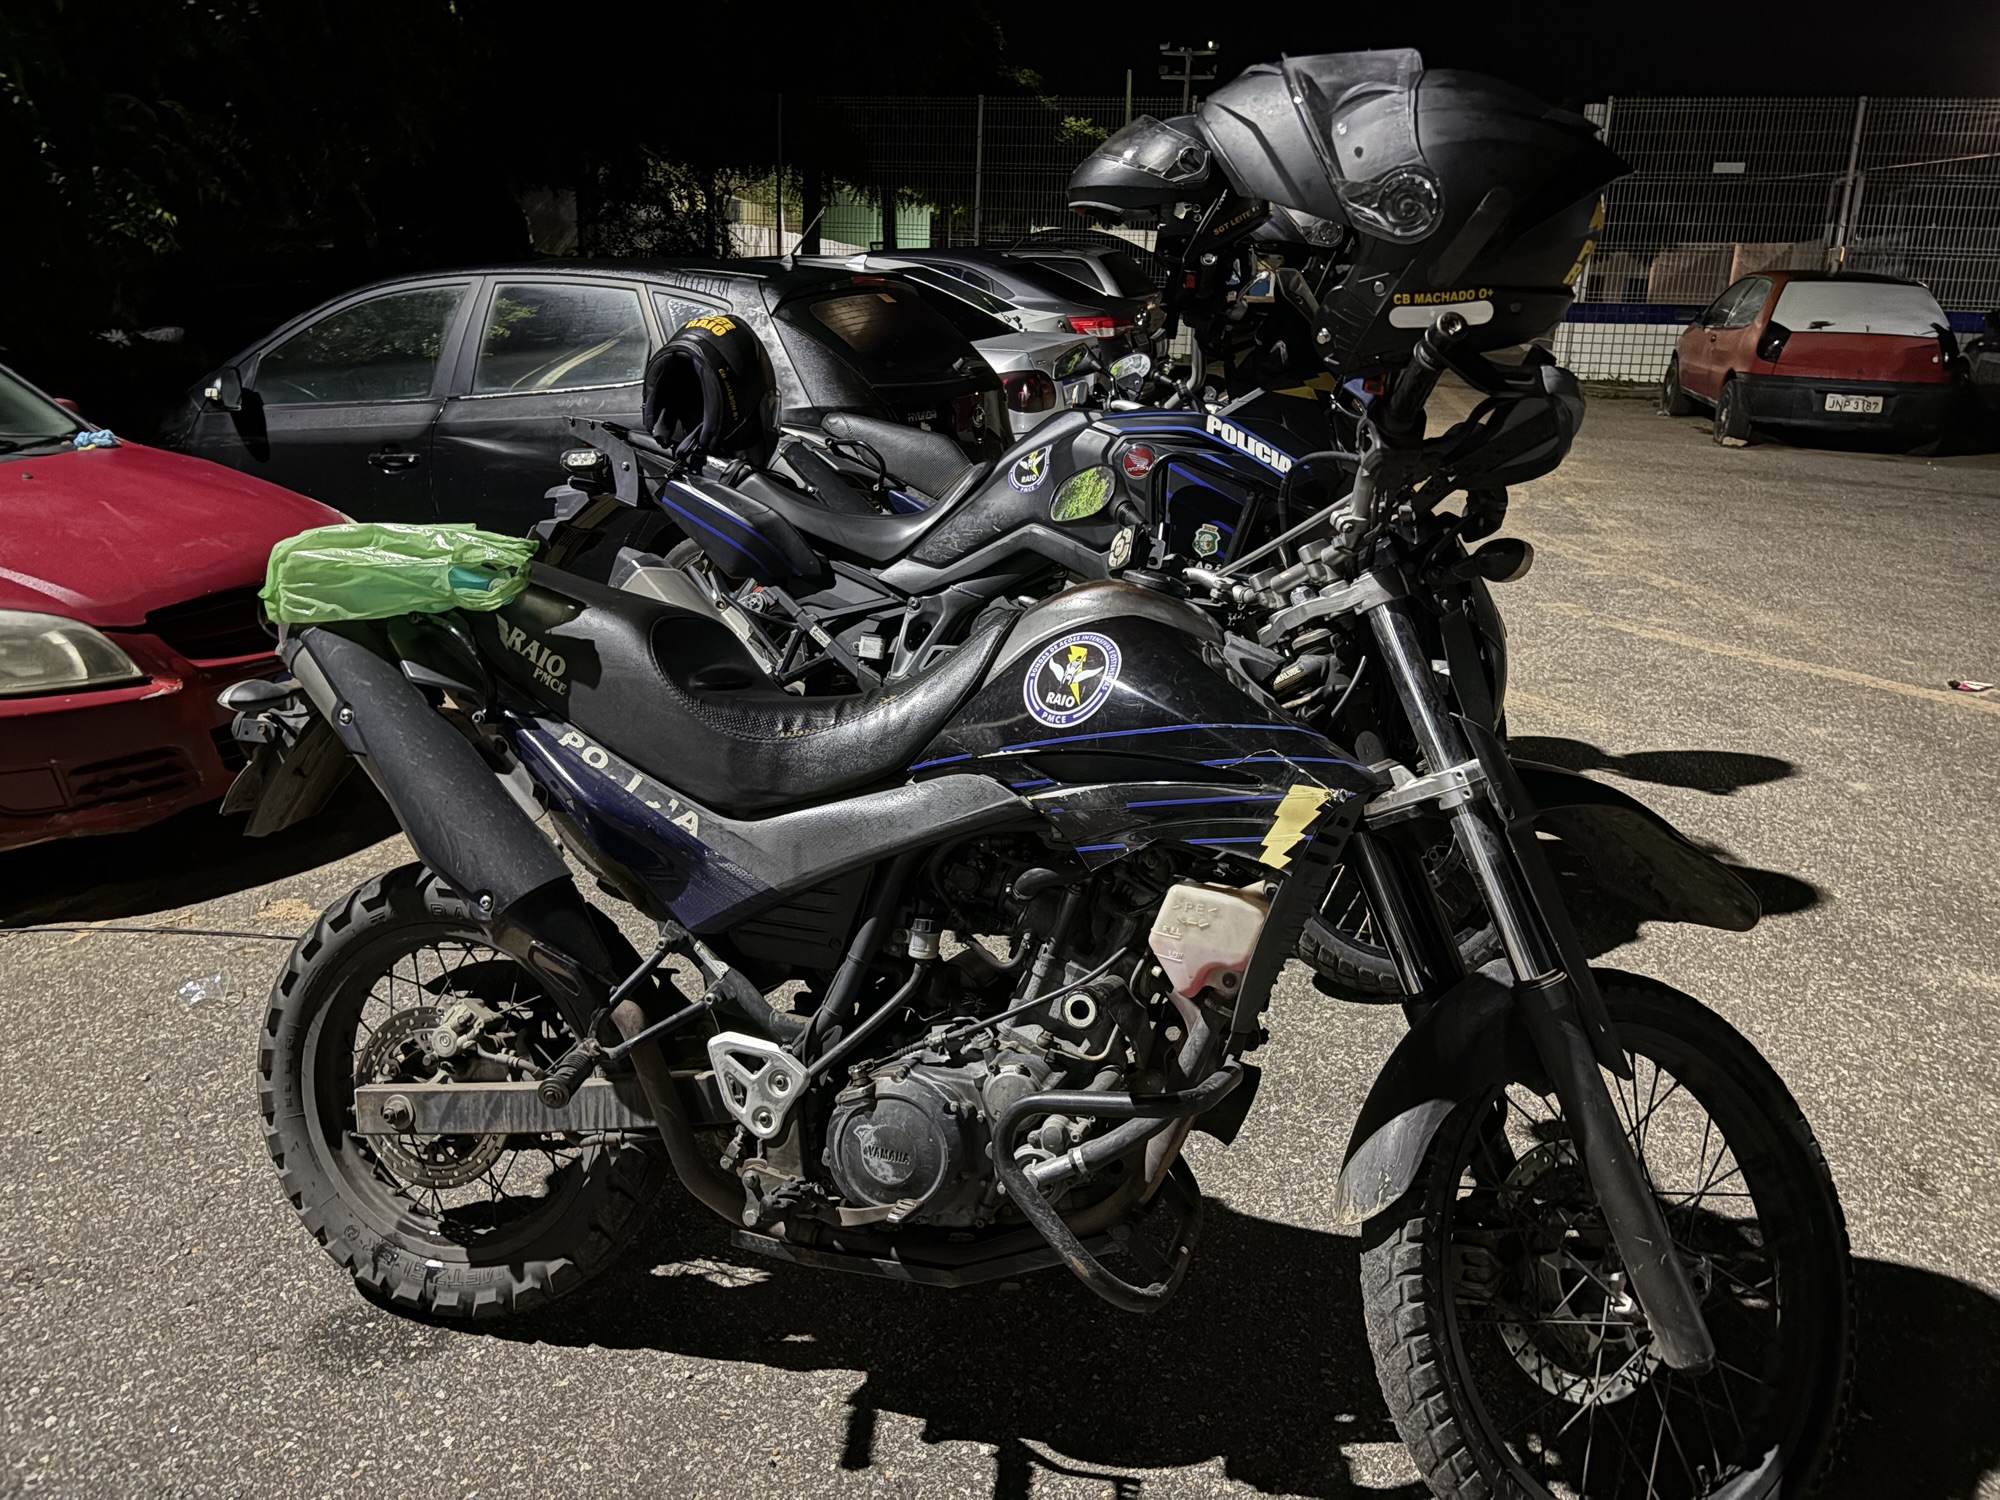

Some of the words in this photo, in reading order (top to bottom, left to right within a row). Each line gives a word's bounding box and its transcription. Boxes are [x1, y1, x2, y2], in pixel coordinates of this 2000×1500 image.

[1212, 222, 1229, 236] SGT
[1393, 293, 1411, 305] CB
[1413, 289, 1476, 304] MACHADO
[685, 319, 727, 336] RAIO
[1020, 475, 1037, 483] RAIO
[507, 625, 567, 677] RAIO
[1049, 644, 1059, 653] DE
[532, 666, 568, 696] PMCE
[1045, 691, 1076, 709] RAIO
[1041, 711, 1067, 724] PMCE
[867, 1145, 910, 1165] YAMAHA
